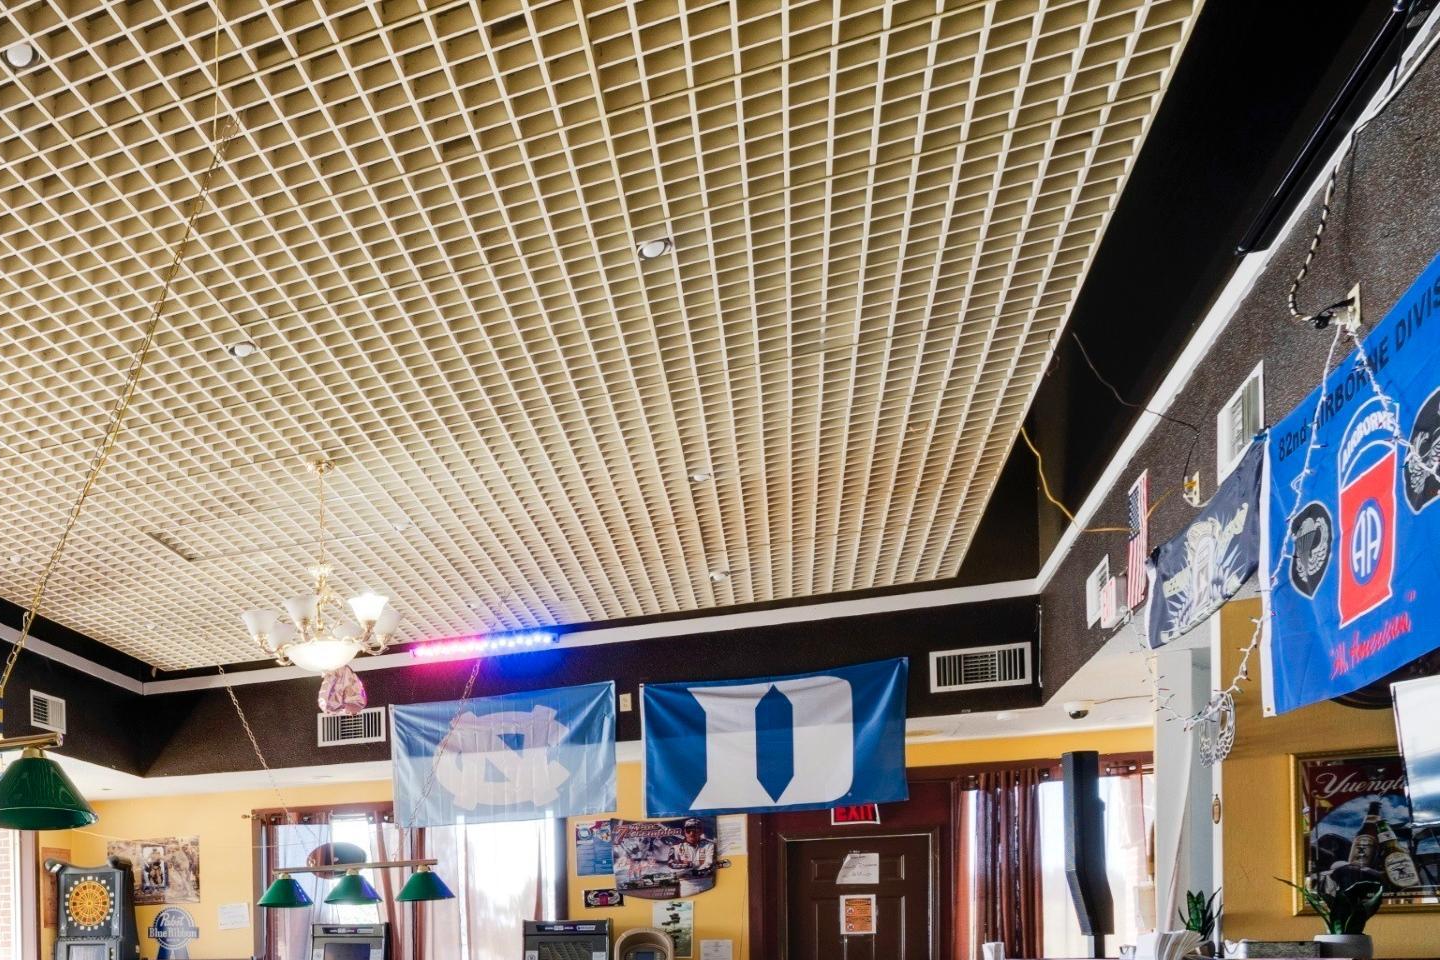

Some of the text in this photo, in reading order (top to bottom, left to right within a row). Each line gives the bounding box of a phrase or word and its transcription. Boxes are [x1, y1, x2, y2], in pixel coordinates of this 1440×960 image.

[1278, 416, 1307, 462] 82nd
[835, 804, 875, 820] EXIT
[160, 912, 184, 926] Pabst
[149, 927, 168, 938] Blue
